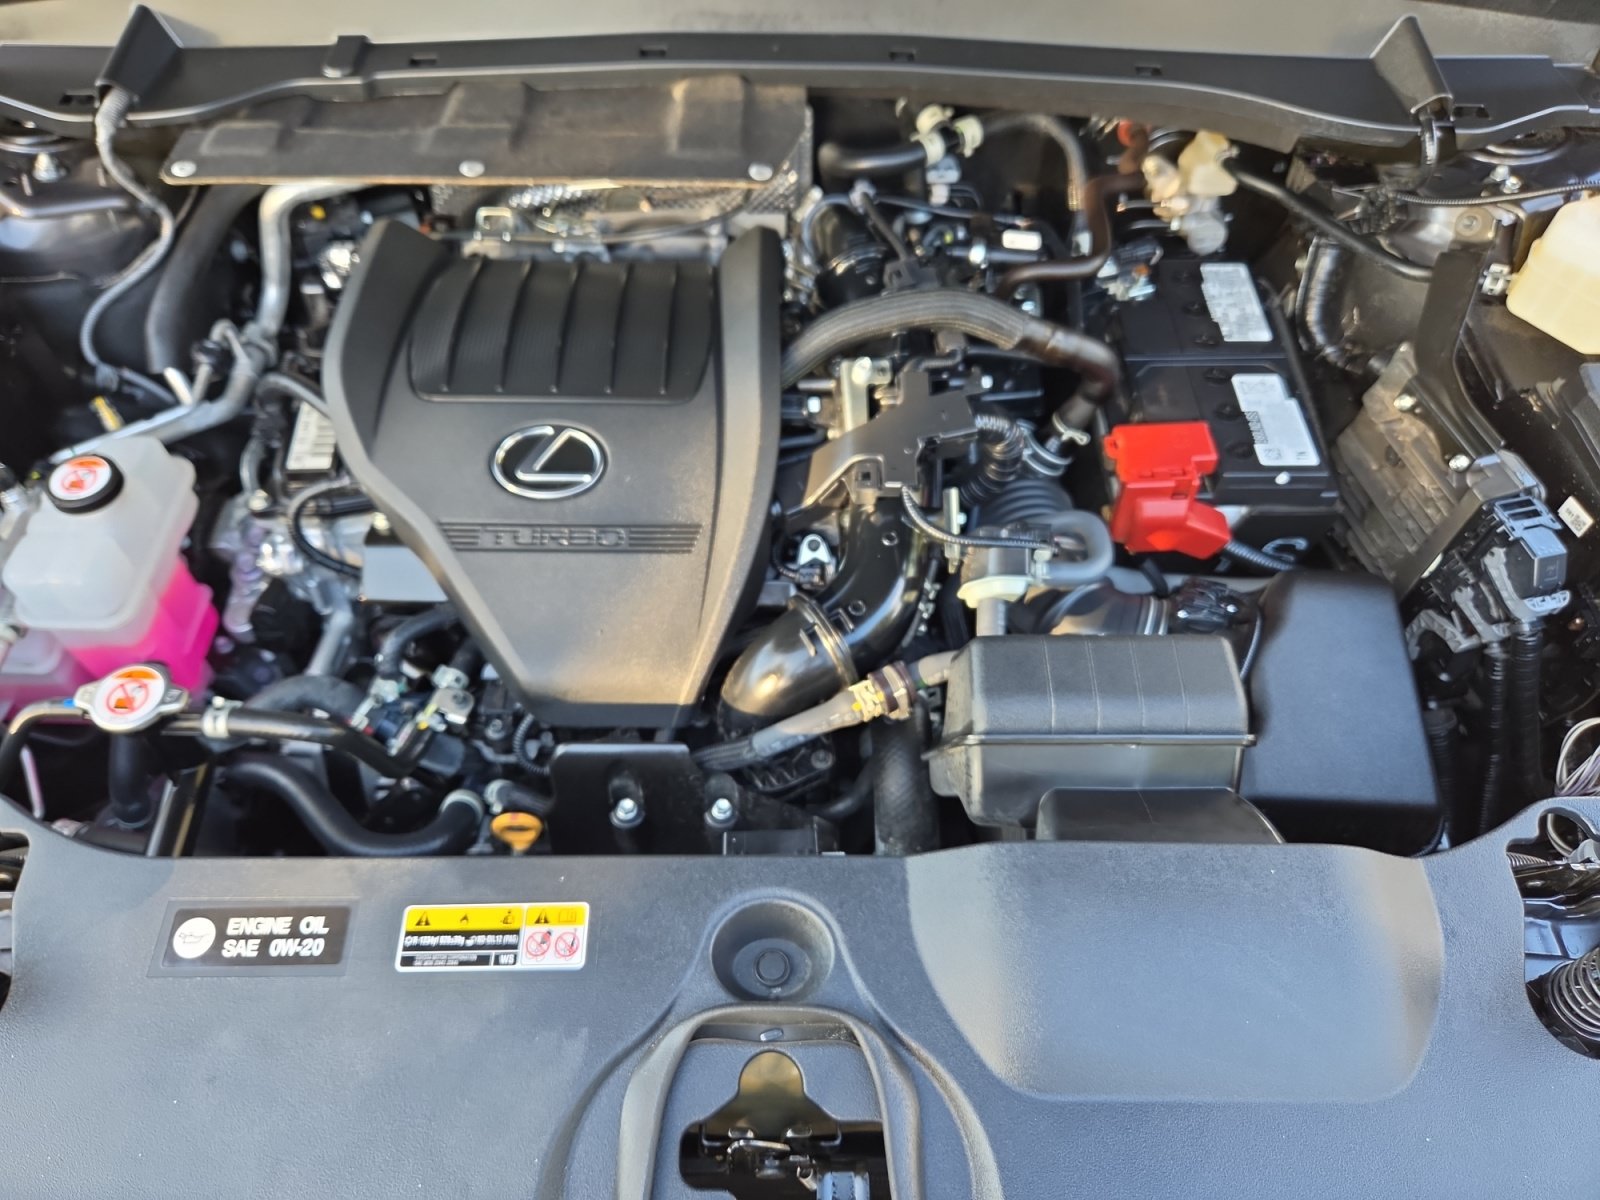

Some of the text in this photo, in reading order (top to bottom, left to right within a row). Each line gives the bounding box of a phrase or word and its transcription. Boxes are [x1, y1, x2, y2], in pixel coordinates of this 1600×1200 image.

[483, 525, 627, 547] TURBO
[226, 915, 330, 935] ENGINE OIL
[221, 938, 326, 958] SAE 0W-20
